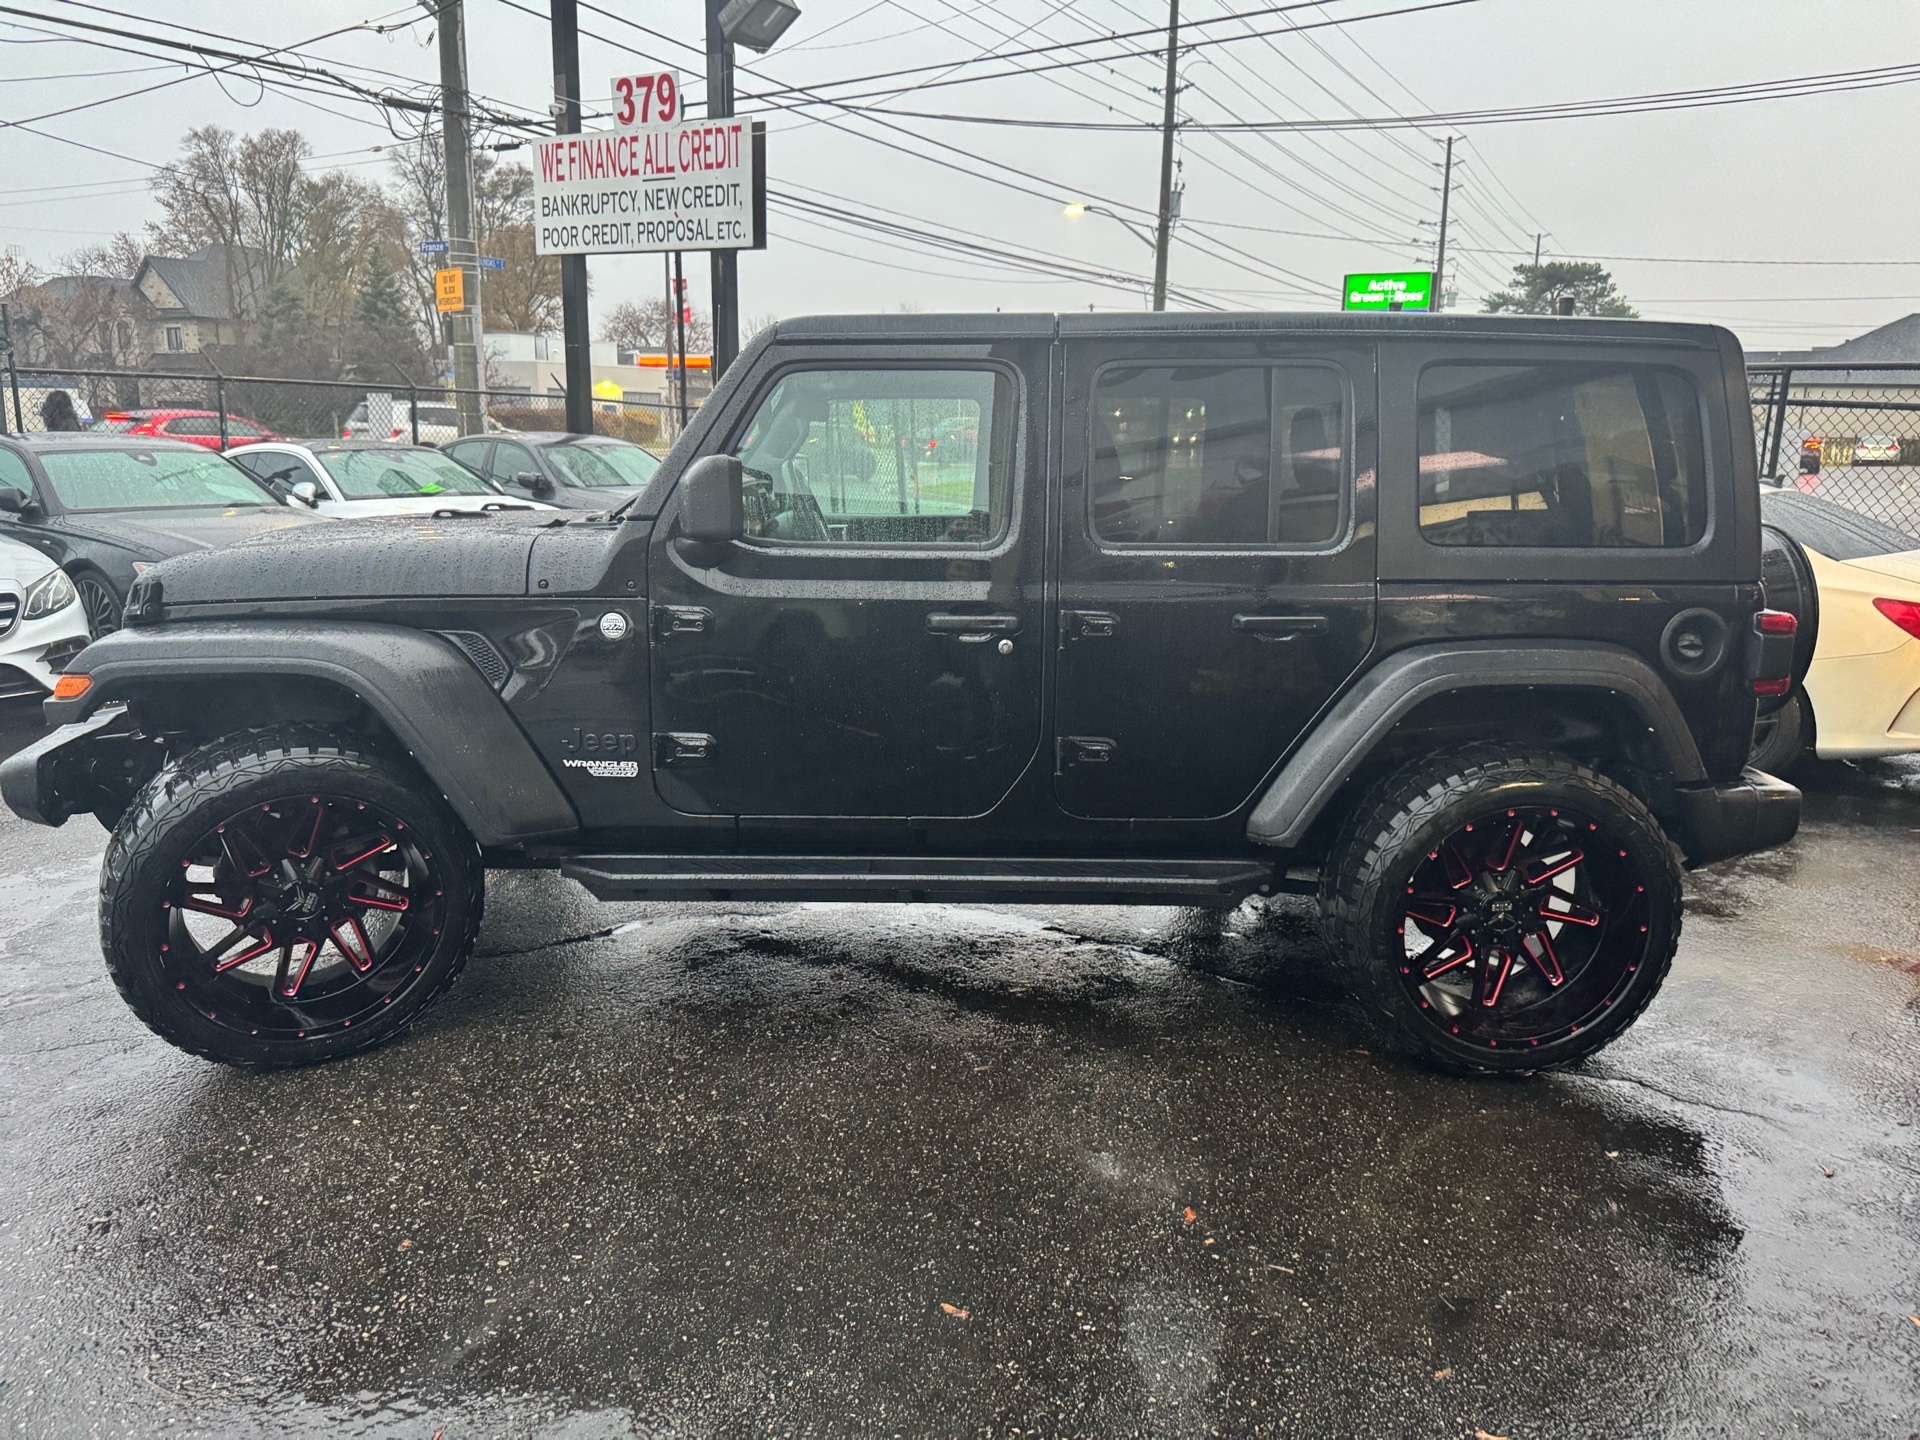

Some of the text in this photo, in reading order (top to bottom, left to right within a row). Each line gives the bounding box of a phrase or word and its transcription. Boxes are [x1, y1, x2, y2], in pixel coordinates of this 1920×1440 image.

[615, 73, 676, 125] 379
[539, 125, 742, 183] WE FINANCE ALL CREDIT
[542, 183, 743, 217] BANKRUPTCY, NEW CREDIT,
[421, 242, 444, 252] Franze
[543, 218, 746, 248] POOR CREDIT, PROPOSAL ETC.
[444, 286, 456, 295] BLOCK
[1367, 279, 1407, 291] Active
[561, 727, 638, 757] Jeep
[562, 759, 638, 767] WRANGLER
